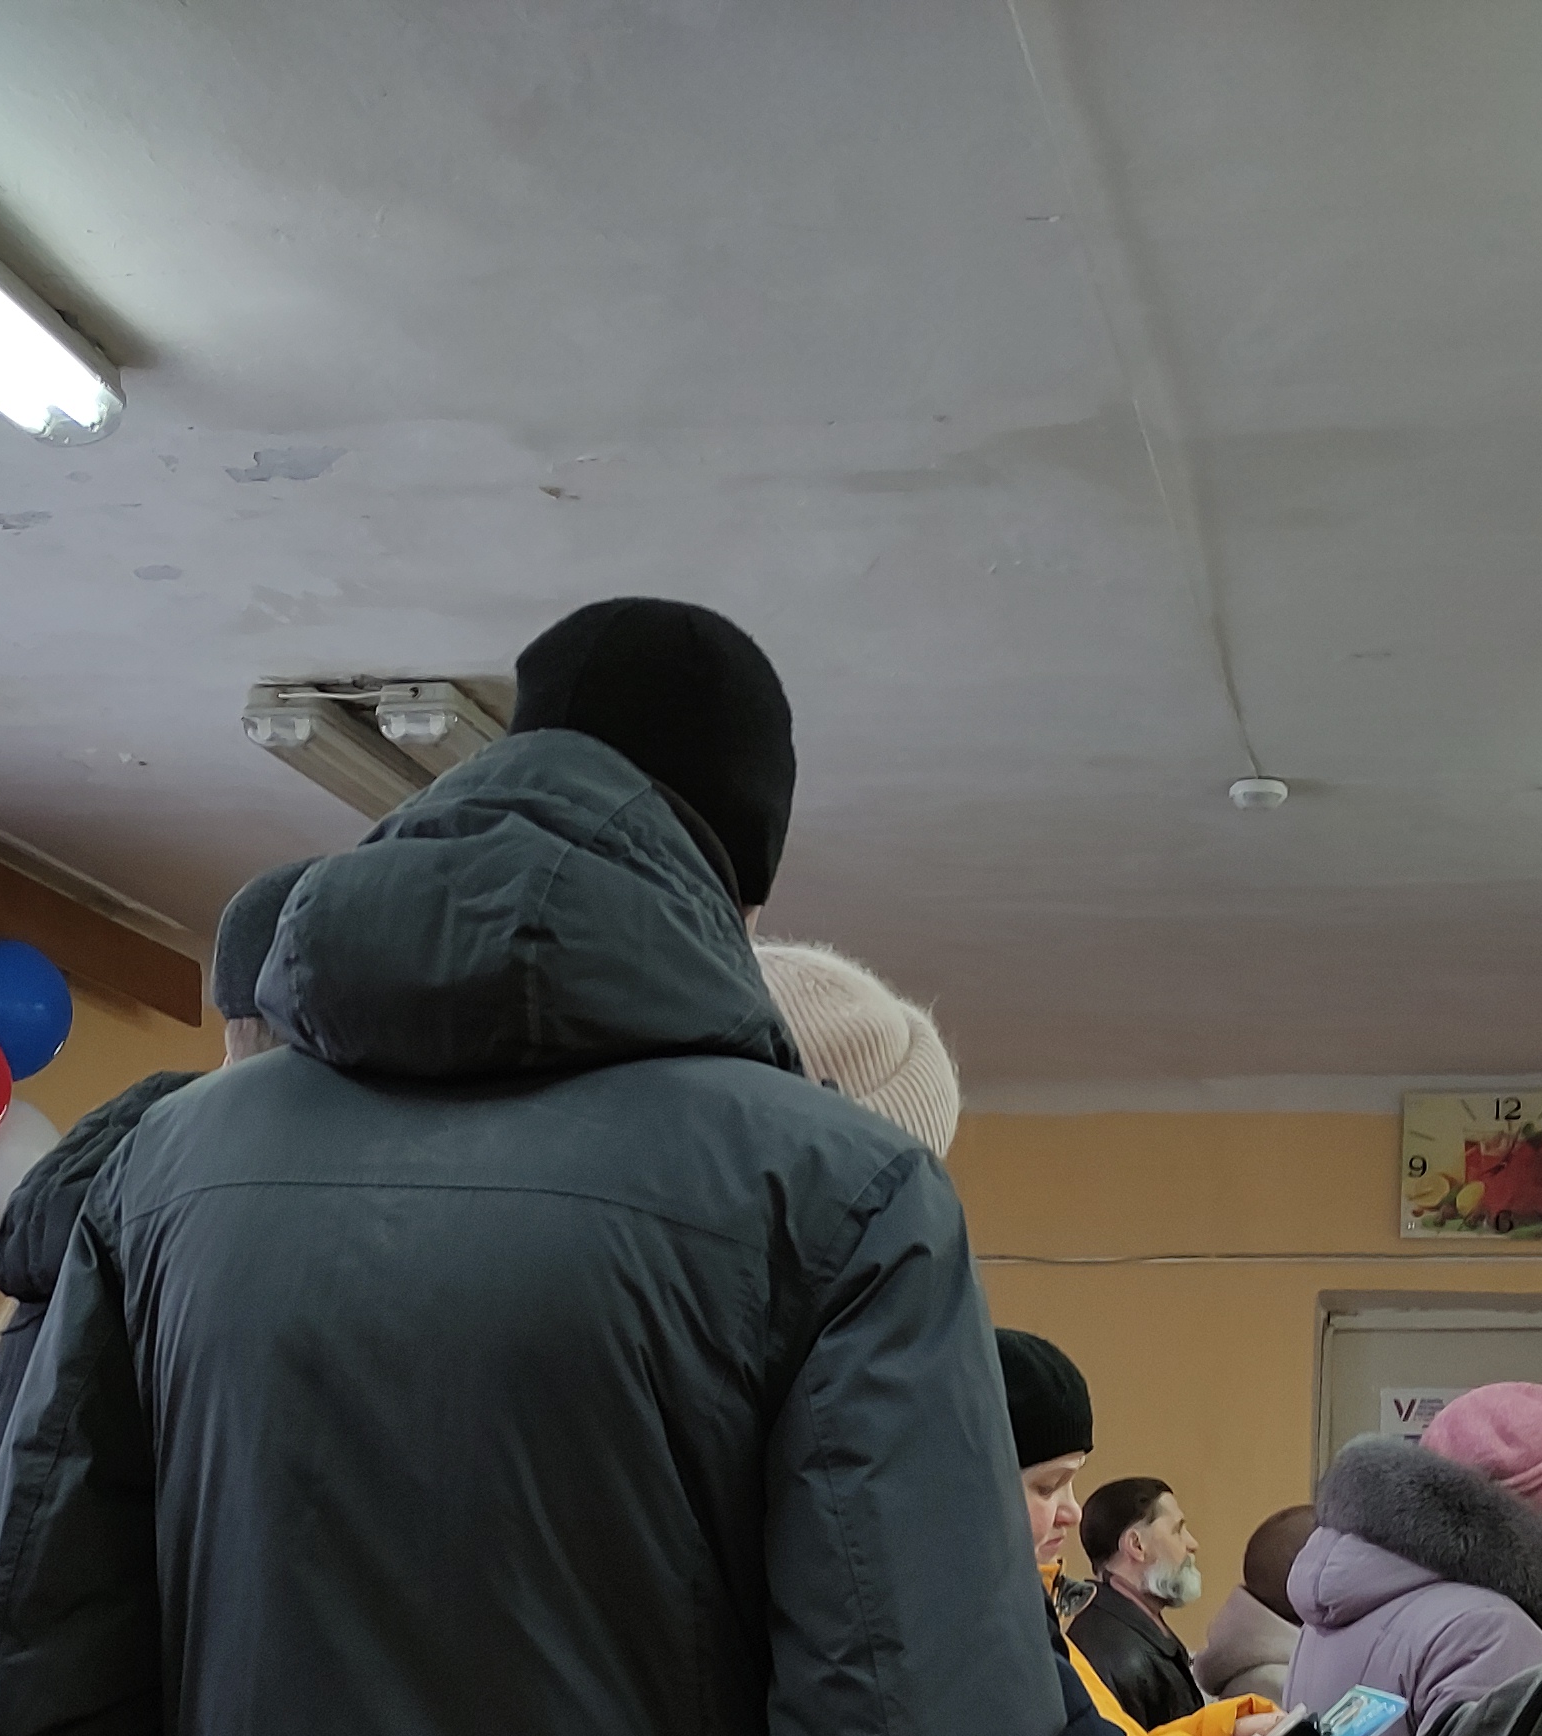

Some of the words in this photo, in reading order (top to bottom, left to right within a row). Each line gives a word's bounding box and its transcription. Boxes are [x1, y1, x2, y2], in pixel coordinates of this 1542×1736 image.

[1494, 1097, 1522, 1121] 12
[1408, 1154, 1428, 1178] 9
[1495, 1210, 1514, 1234] 6
